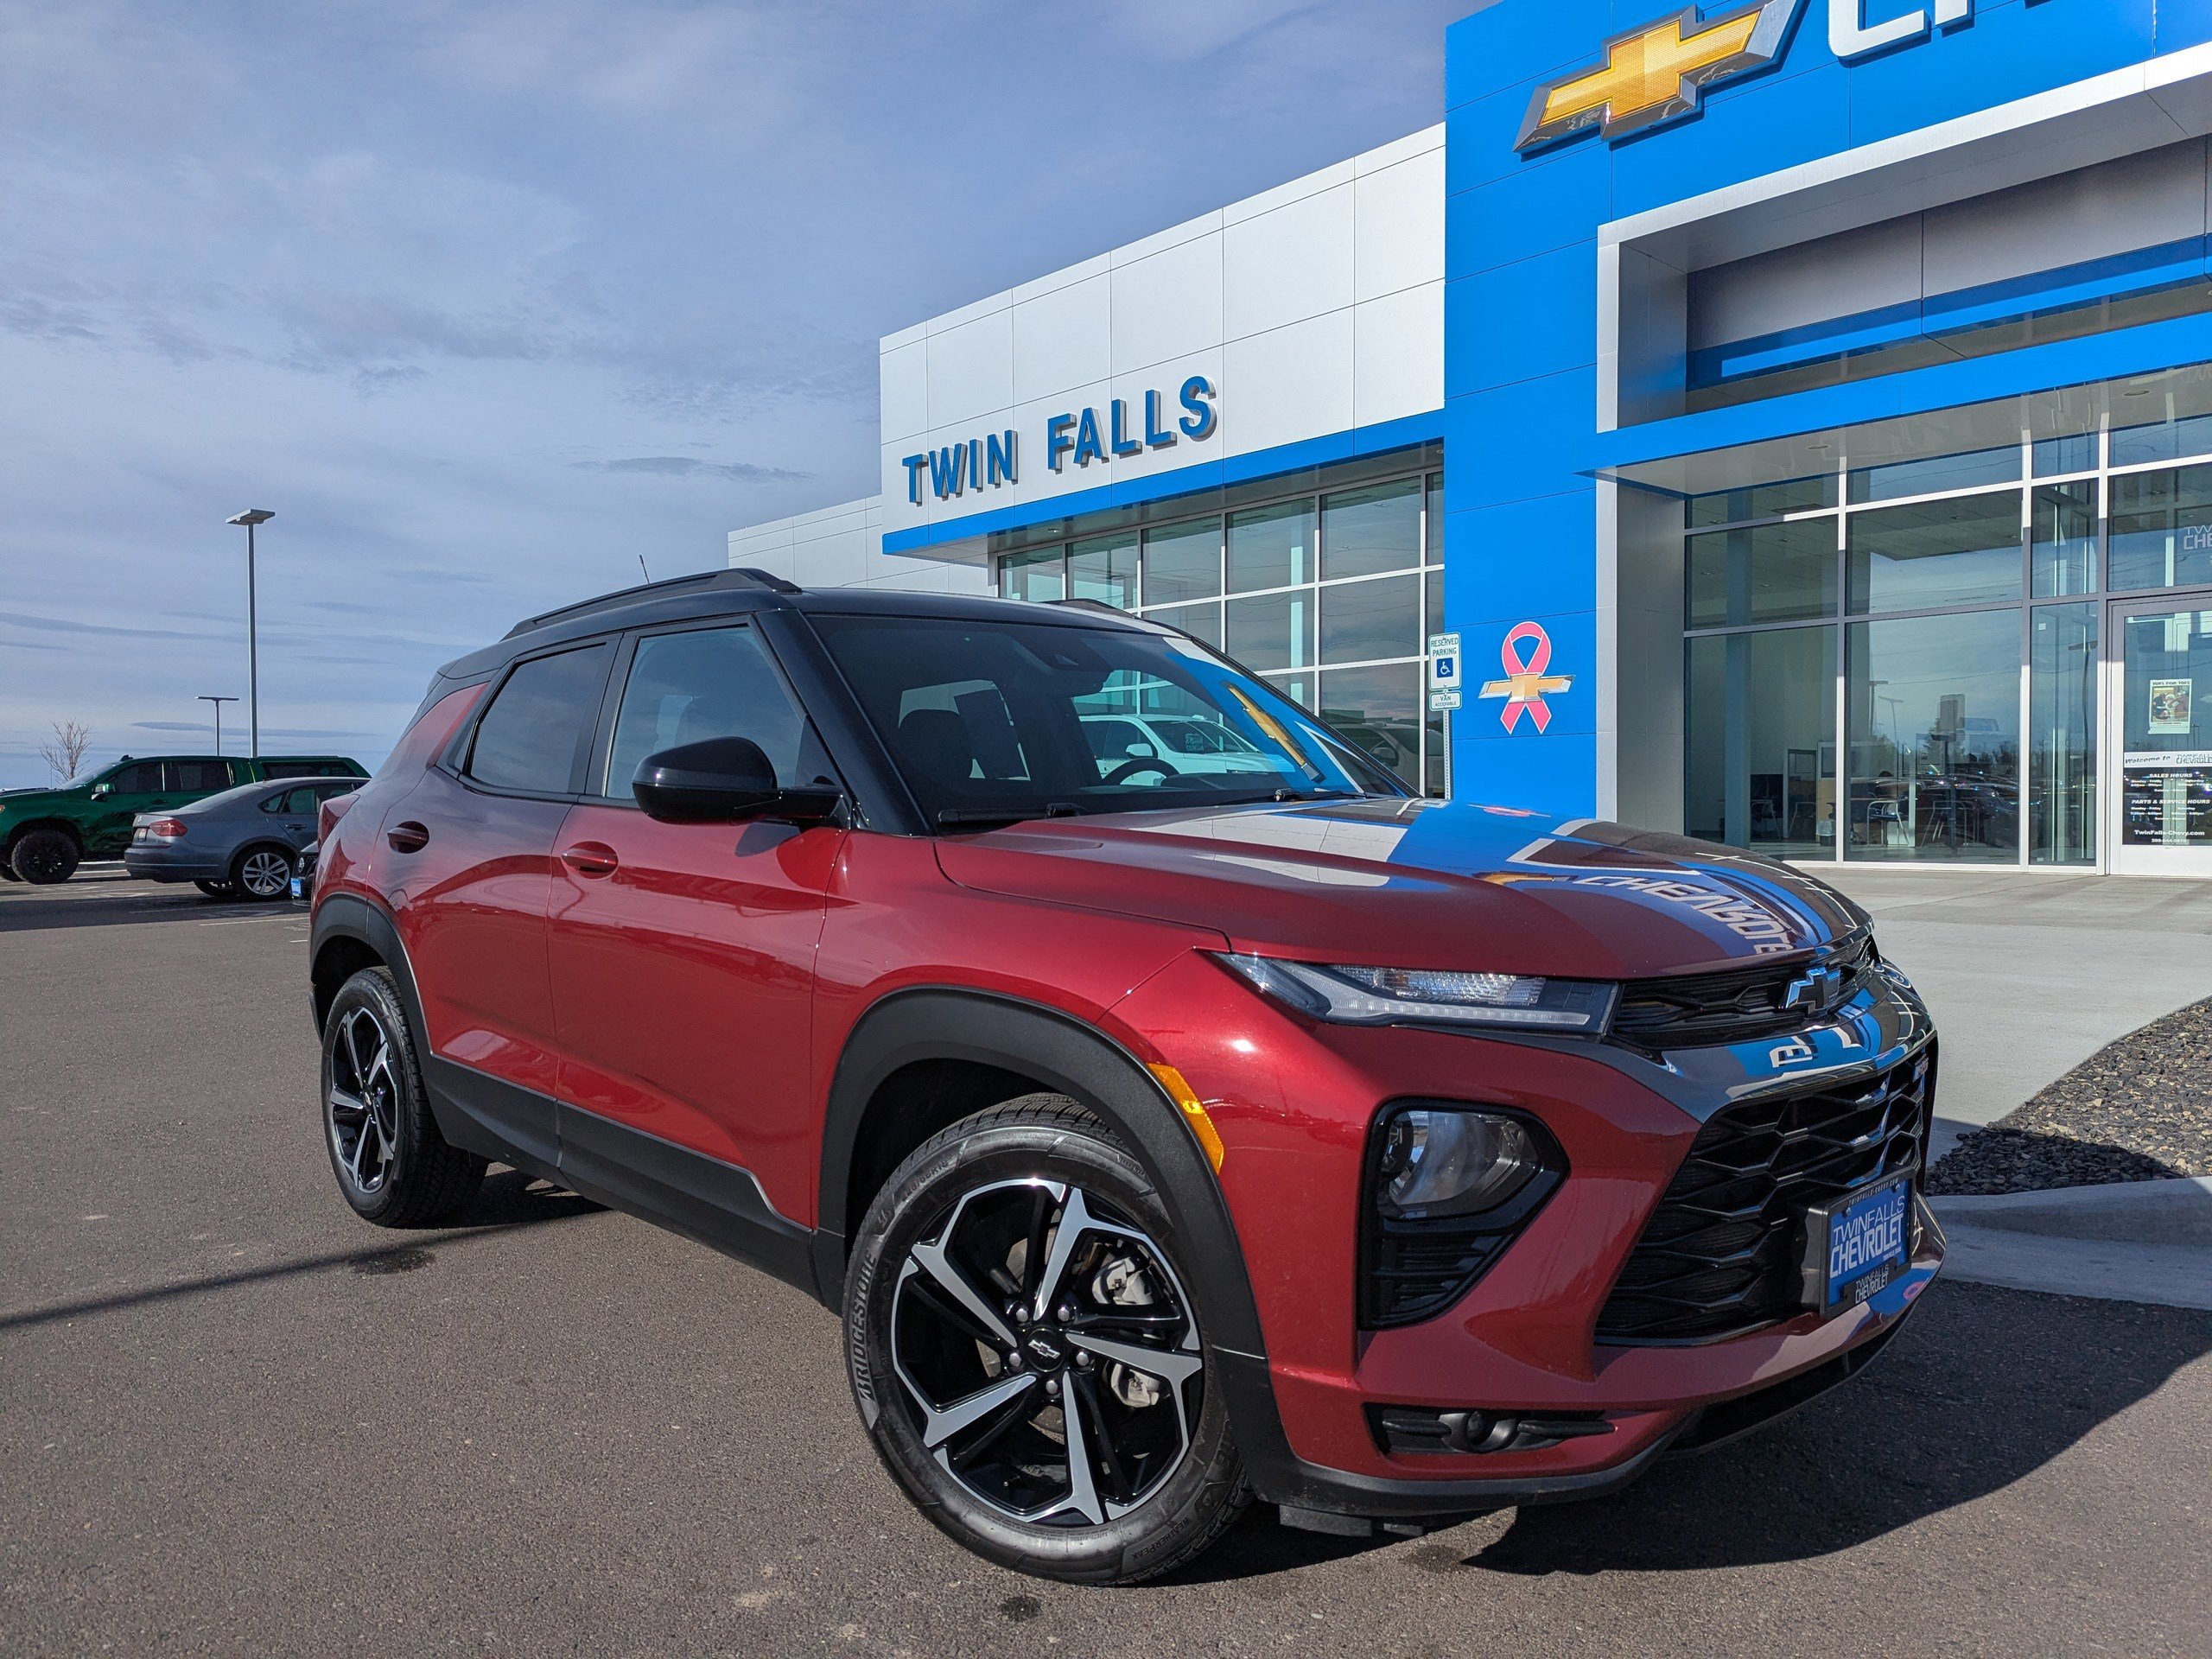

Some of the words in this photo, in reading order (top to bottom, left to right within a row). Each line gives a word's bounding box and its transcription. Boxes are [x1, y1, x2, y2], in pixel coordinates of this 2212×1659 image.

[902, 429, 1018, 506] TWIN
[1047, 375, 1217, 474] FALLS
[1430, 637, 1459, 648] RESERVED
[1432, 647, 1457, 658] PARKING
[1834, 1195, 1905, 1246] TWINFALLS
[1829, 1212, 1904, 1279] CHEVROLET
[1855, 1273, 1889, 1305] CHEVROLET
[1856, 1263, 1890, 1289] TWINFALLS
[851, 1249, 876, 1401] BRIDGESTONE
[1132, 1516, 1192, 1561] WEATHERPEAK
